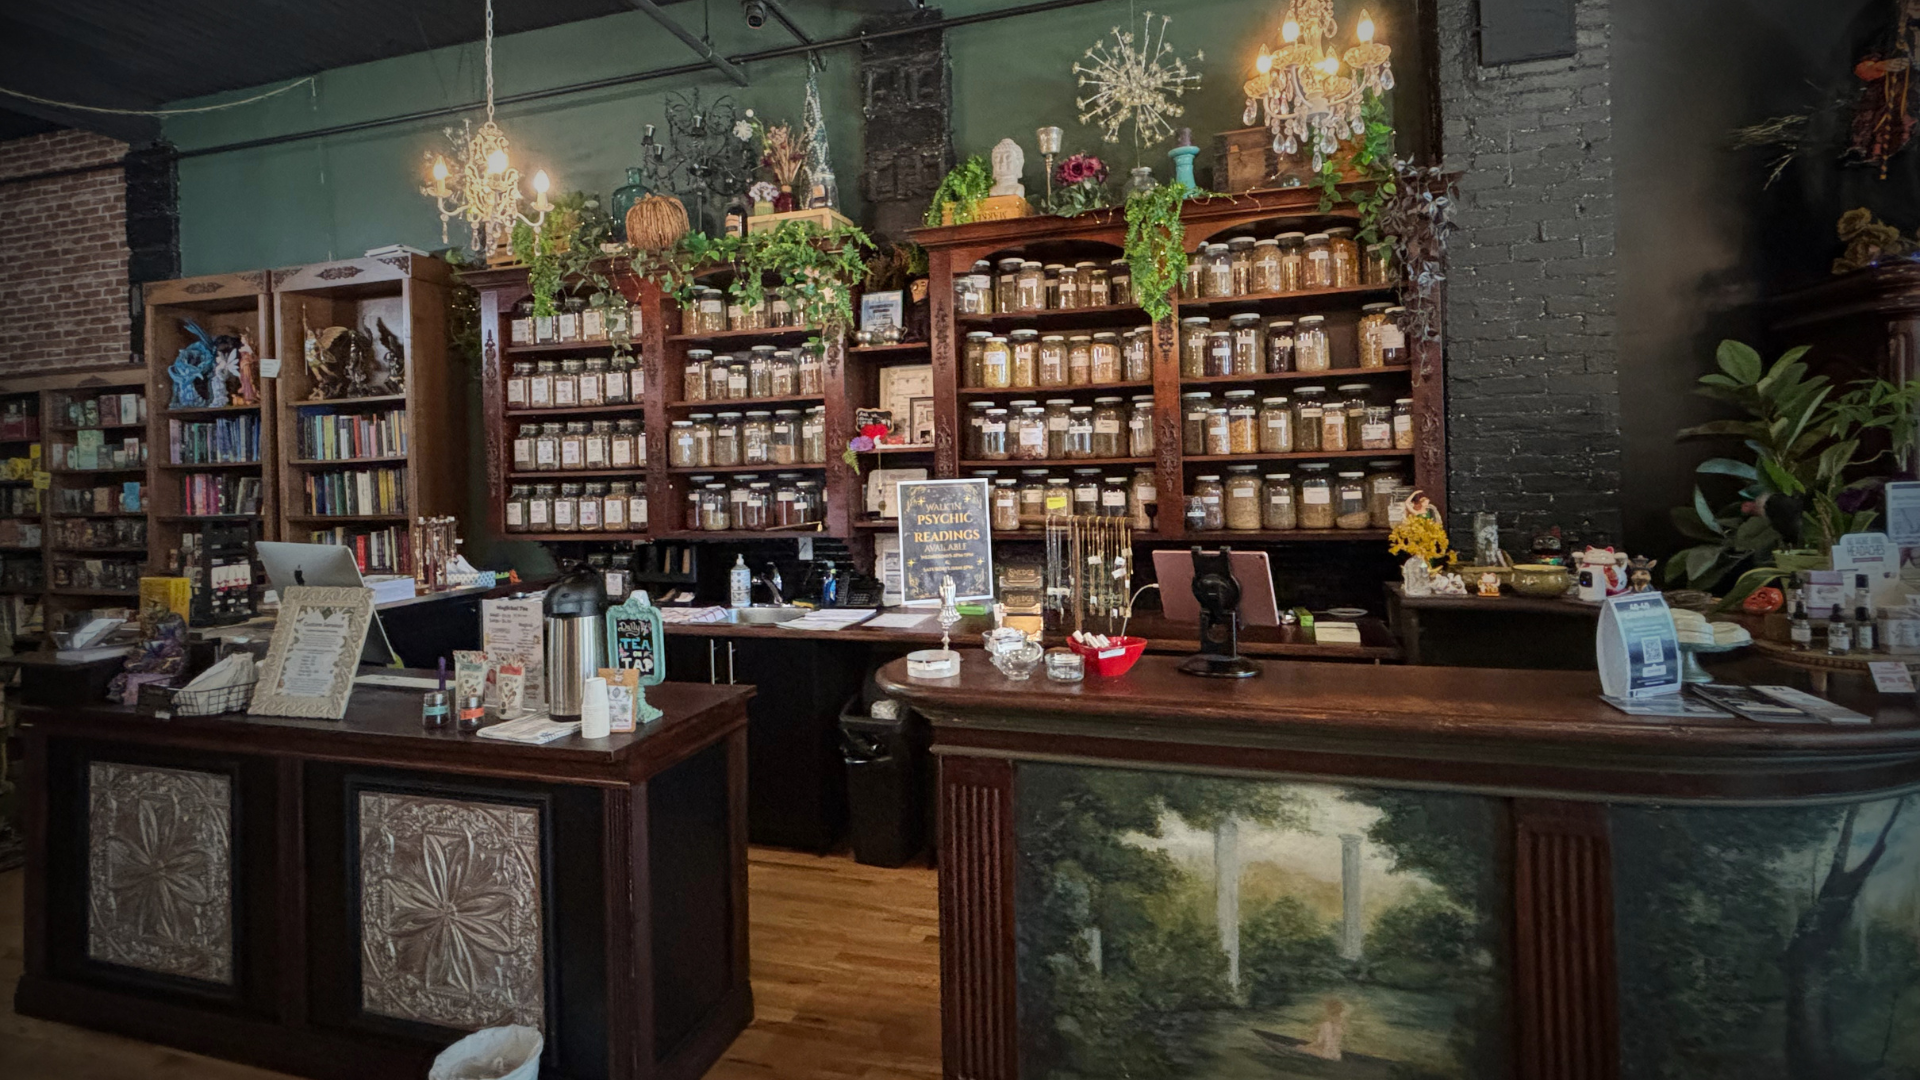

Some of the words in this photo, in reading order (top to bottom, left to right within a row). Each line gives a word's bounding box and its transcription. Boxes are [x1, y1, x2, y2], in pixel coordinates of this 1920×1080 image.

[917, 511, 973, 526] PSYCHIC
[914, 529, 980, 543] READINGS
[924, 543, 967, 553] AVAILABLE
[1846, 544, 1886, 557] HEADACHES
[619, 637, 651, 651] TEA
[621, 657, 654, 672] TAP
